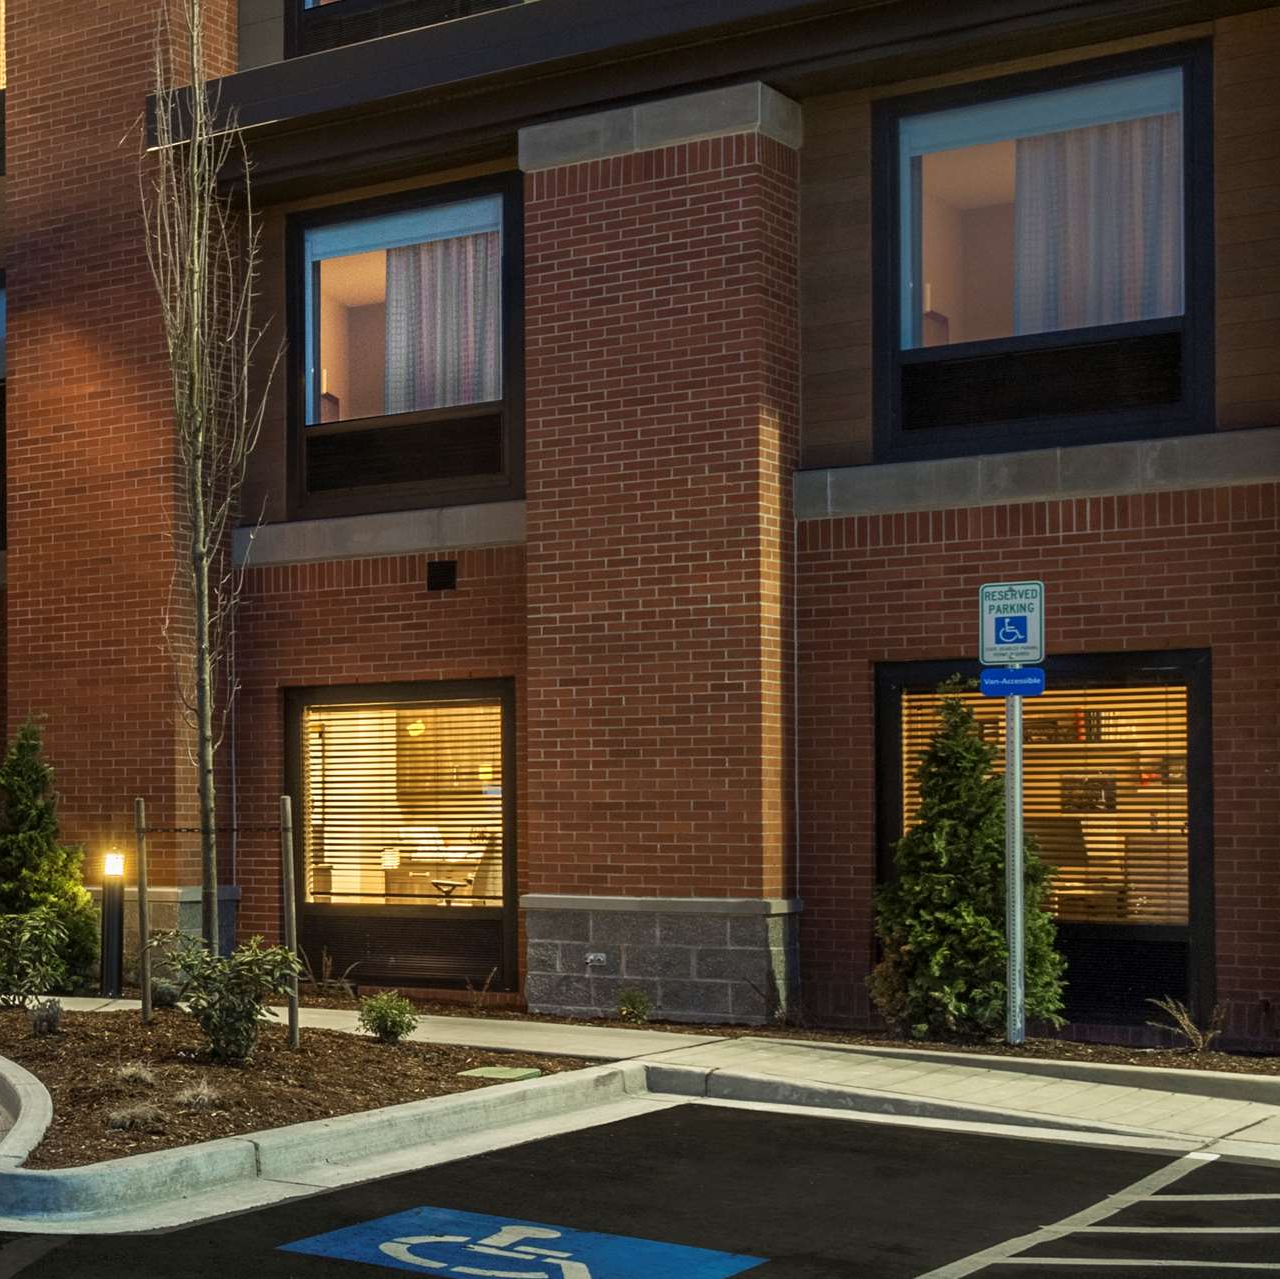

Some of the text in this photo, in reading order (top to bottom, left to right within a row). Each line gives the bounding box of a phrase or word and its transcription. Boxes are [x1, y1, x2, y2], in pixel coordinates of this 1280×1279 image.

[984, 589, 1038, 601] RESERVED
[989, 602, 1035, 614] PARKING
[983, 677, 1041, 685] Van-Accessible
